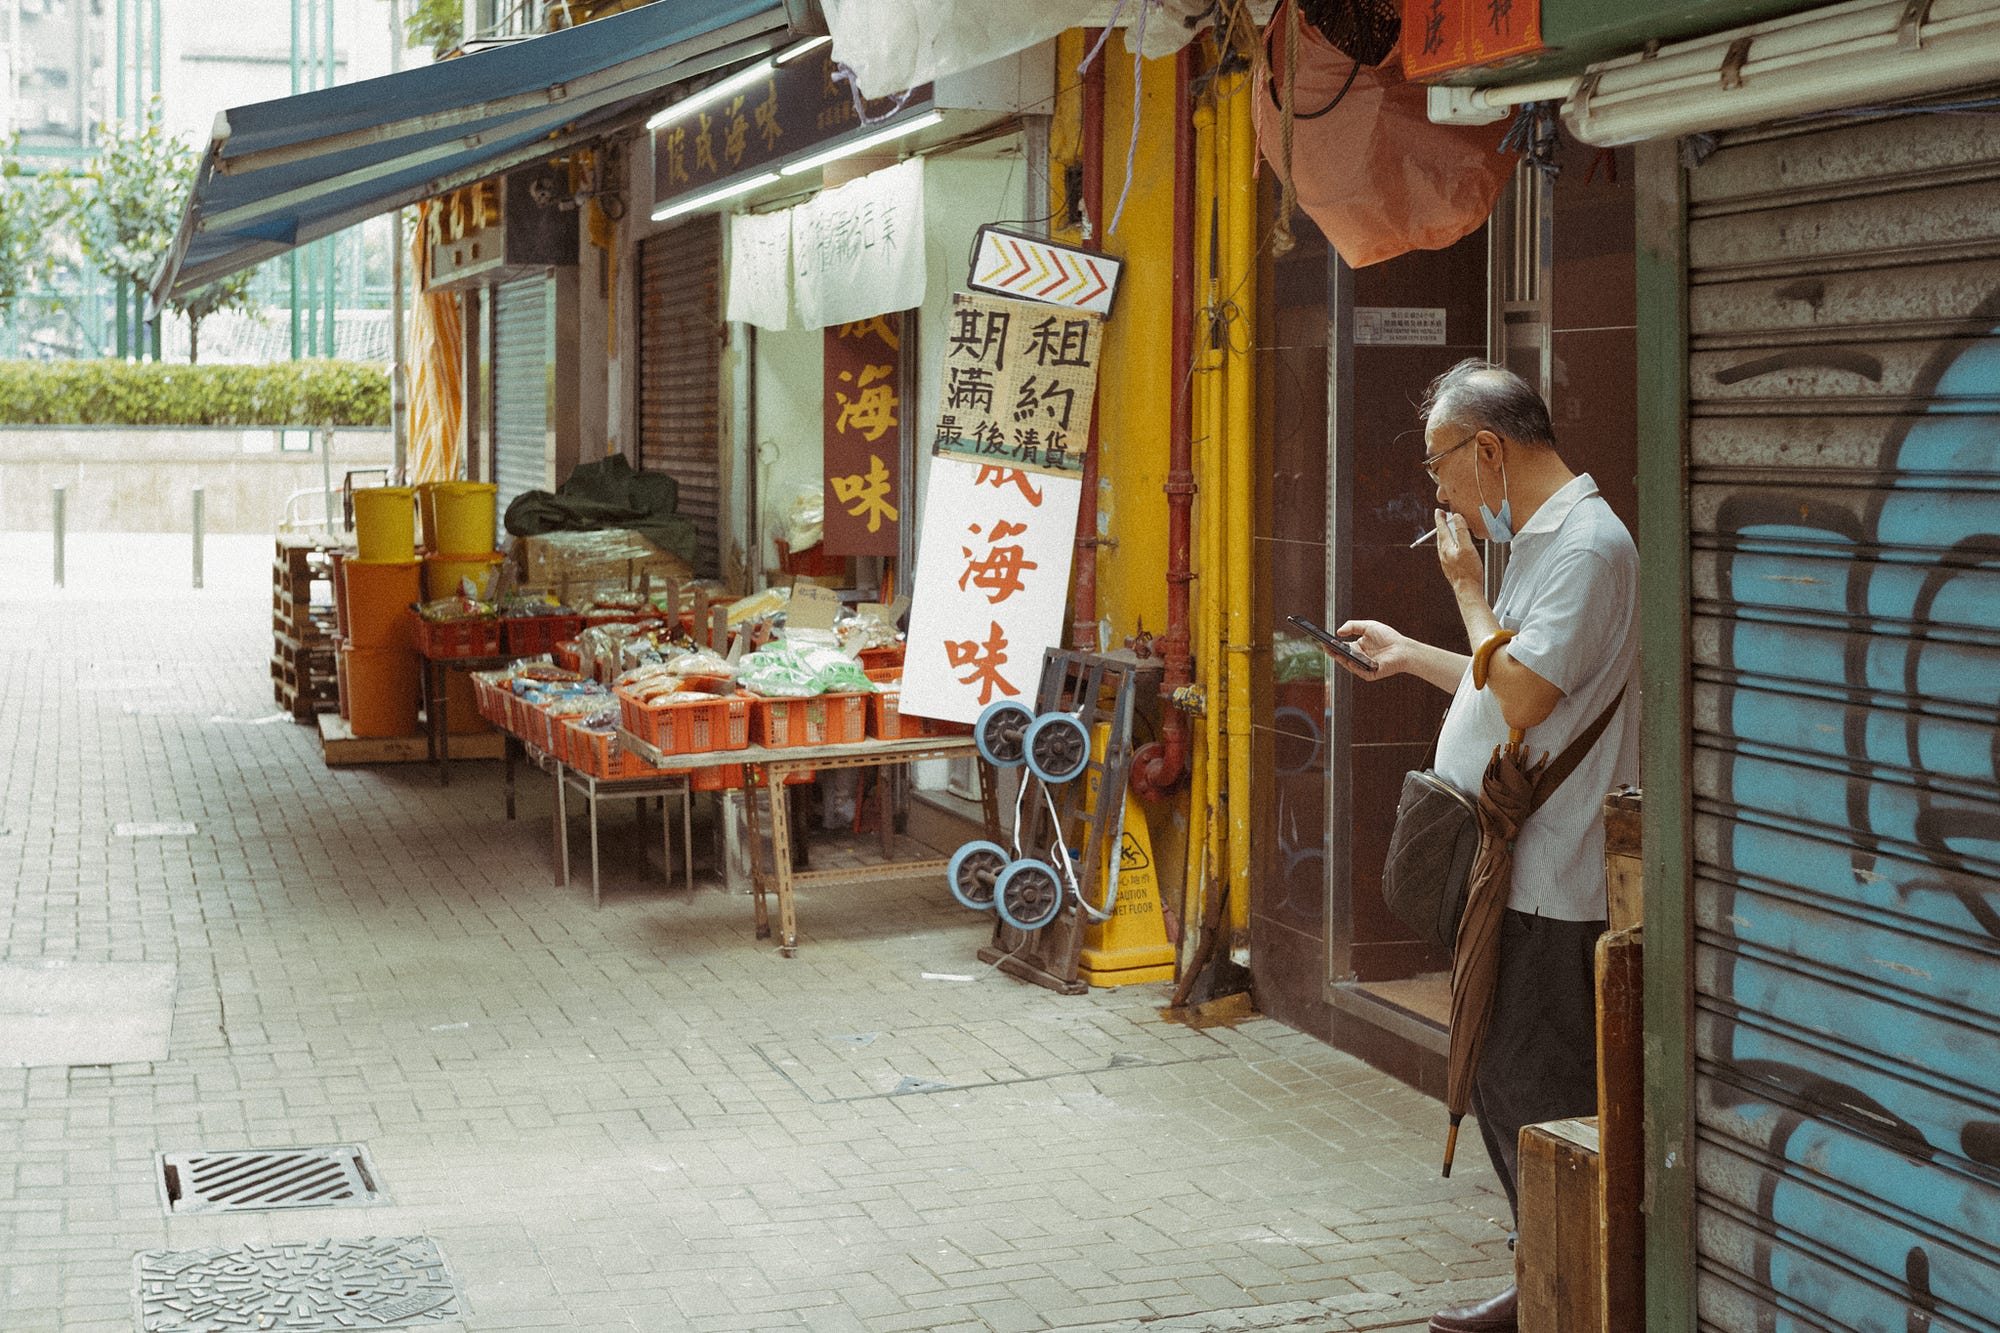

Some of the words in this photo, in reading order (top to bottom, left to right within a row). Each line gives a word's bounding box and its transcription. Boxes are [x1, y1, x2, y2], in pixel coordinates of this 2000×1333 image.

[936, 415, 1068, 471] 最後清貨
[1129, 902, 1153, 915] FLOOR
